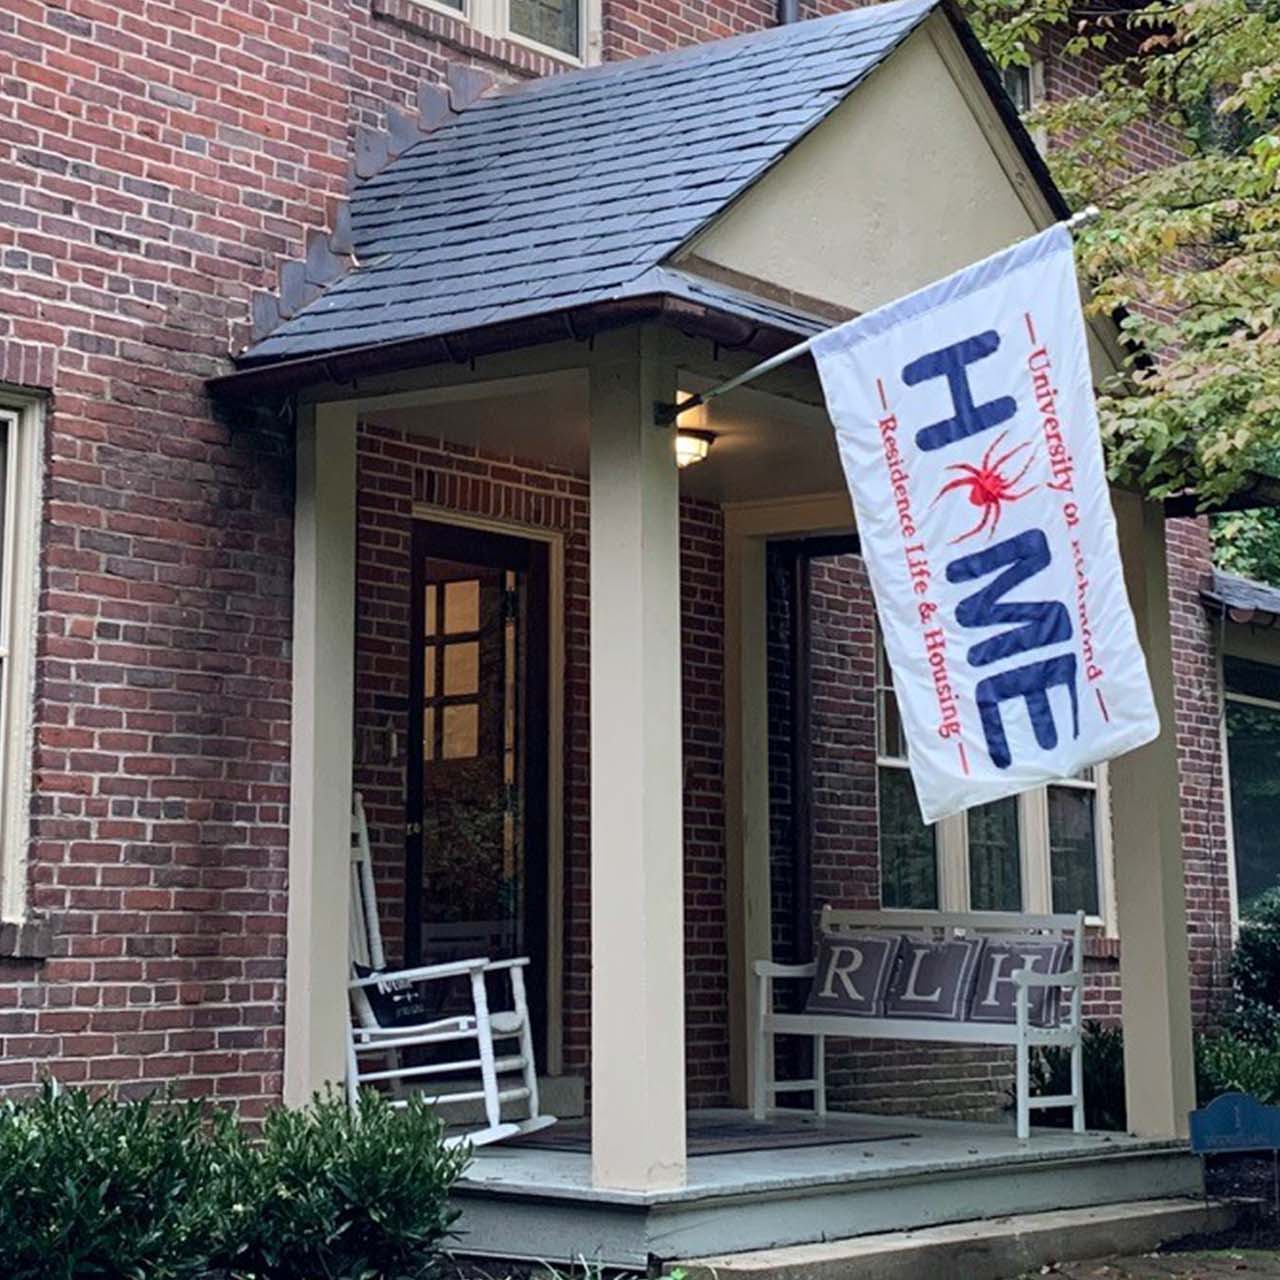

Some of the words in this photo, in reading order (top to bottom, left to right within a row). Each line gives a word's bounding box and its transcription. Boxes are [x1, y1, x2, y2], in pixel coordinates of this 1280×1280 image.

[878, 415, 917, 538] Residence
[1027, 348, 1074, 493] University
[904, 543, 932, 595] Life
[918, 601, 939, 625] &
[923, 626, 963, 740] Housing
